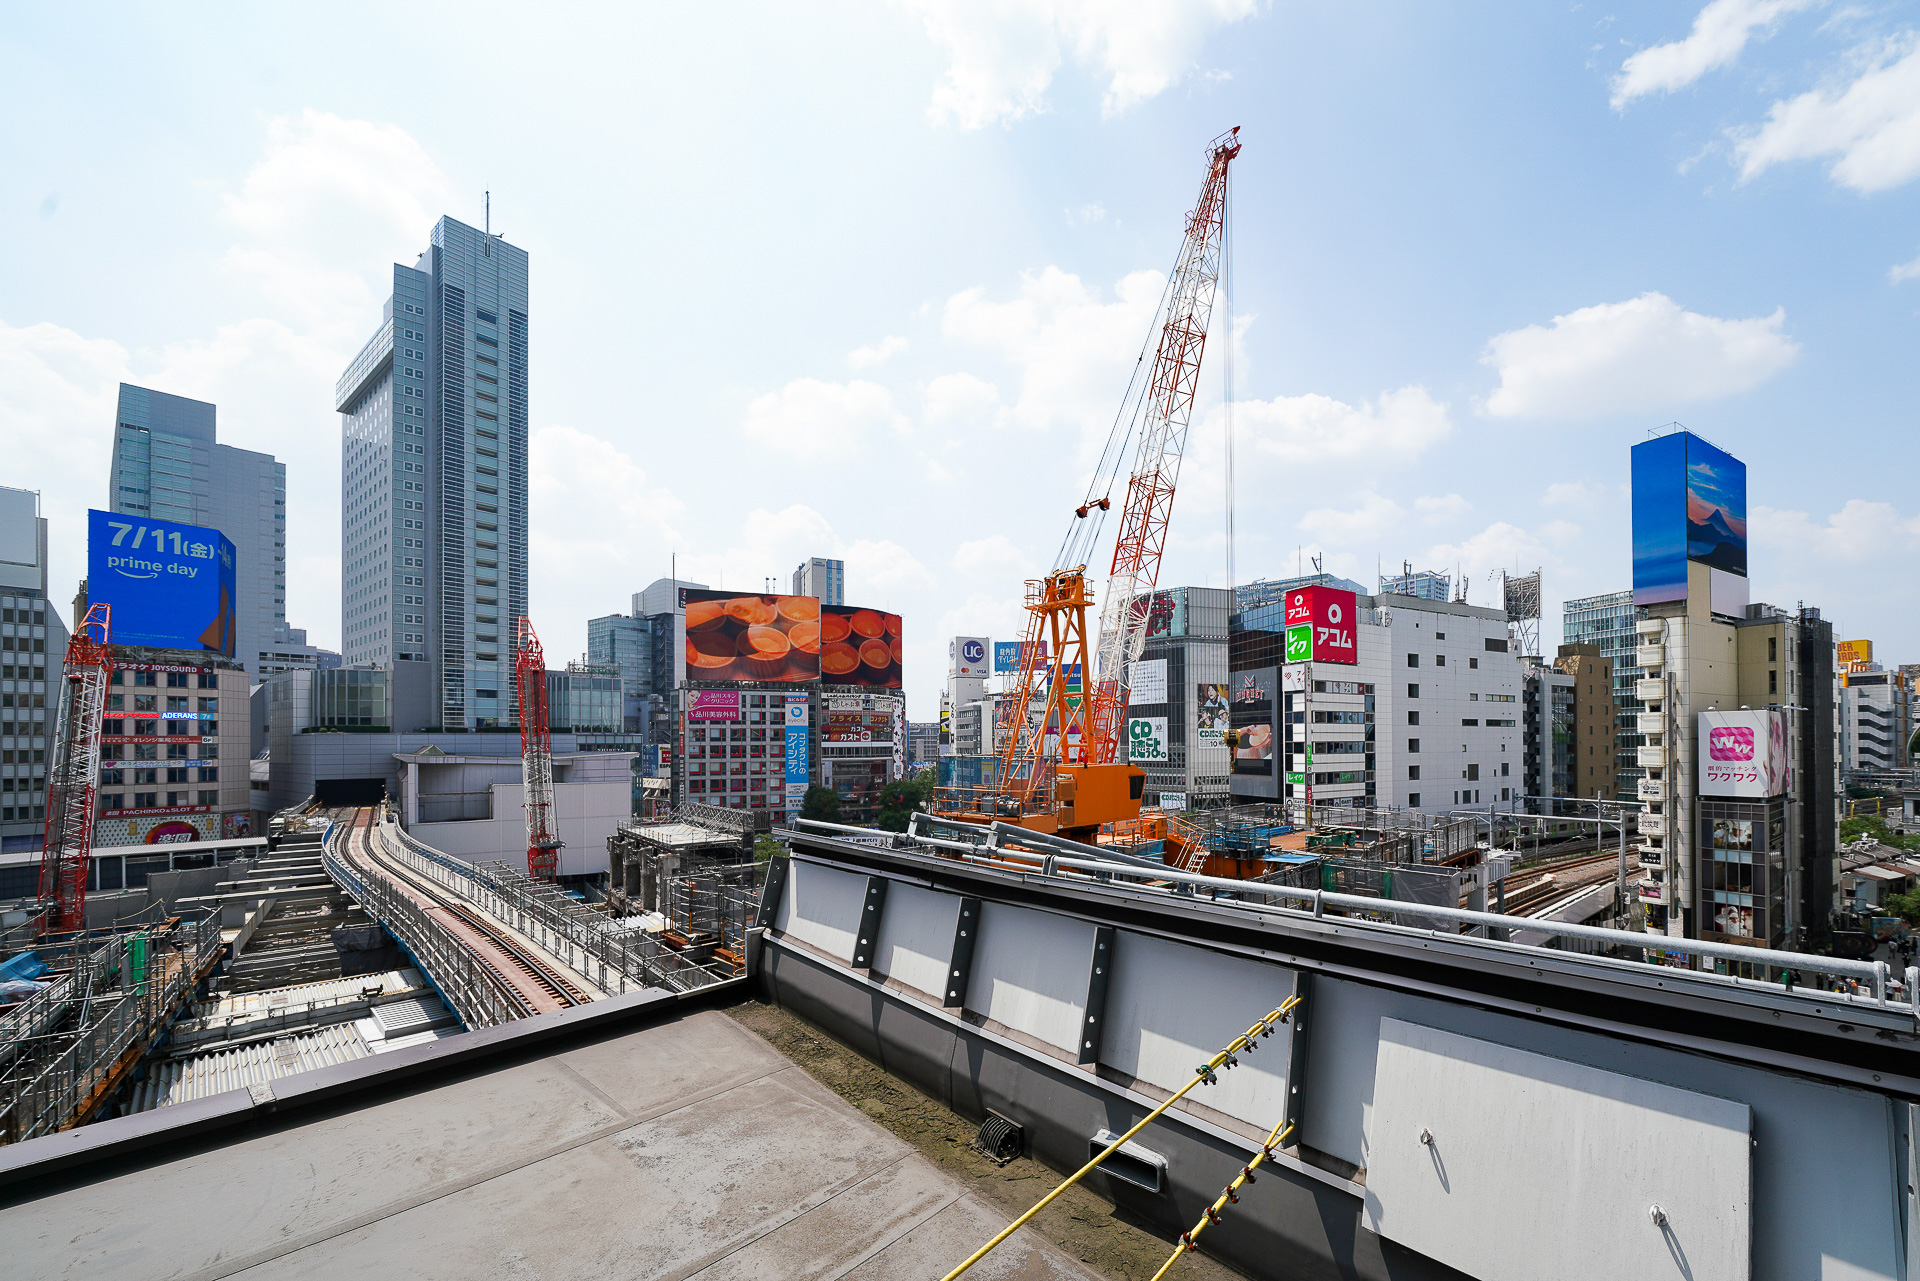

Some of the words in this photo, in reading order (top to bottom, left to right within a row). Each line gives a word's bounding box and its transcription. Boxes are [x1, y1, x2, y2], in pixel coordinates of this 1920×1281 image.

[108, 521, 215, 559] 7/11(金)
[107, 556, 163, 572] prime
[167, 562, 199, 578] day
[1287, 606, 1310, 619] アコム
[1317, 626, 1353, 649] アコム
[963, 646, 983, 659] UC
[150, 665, 198, 673] JOYSOUND
[695, 710, 737, 718] 品川美容外科
[841, 733, 860, 741] ガスト
[1130, 719, 1153, 741] CD
[788, 733, 798, 775] アイシティ
[799, 733, 807, 775] コンタクトの
[1707, 772, 1758, 783] ワクワク
